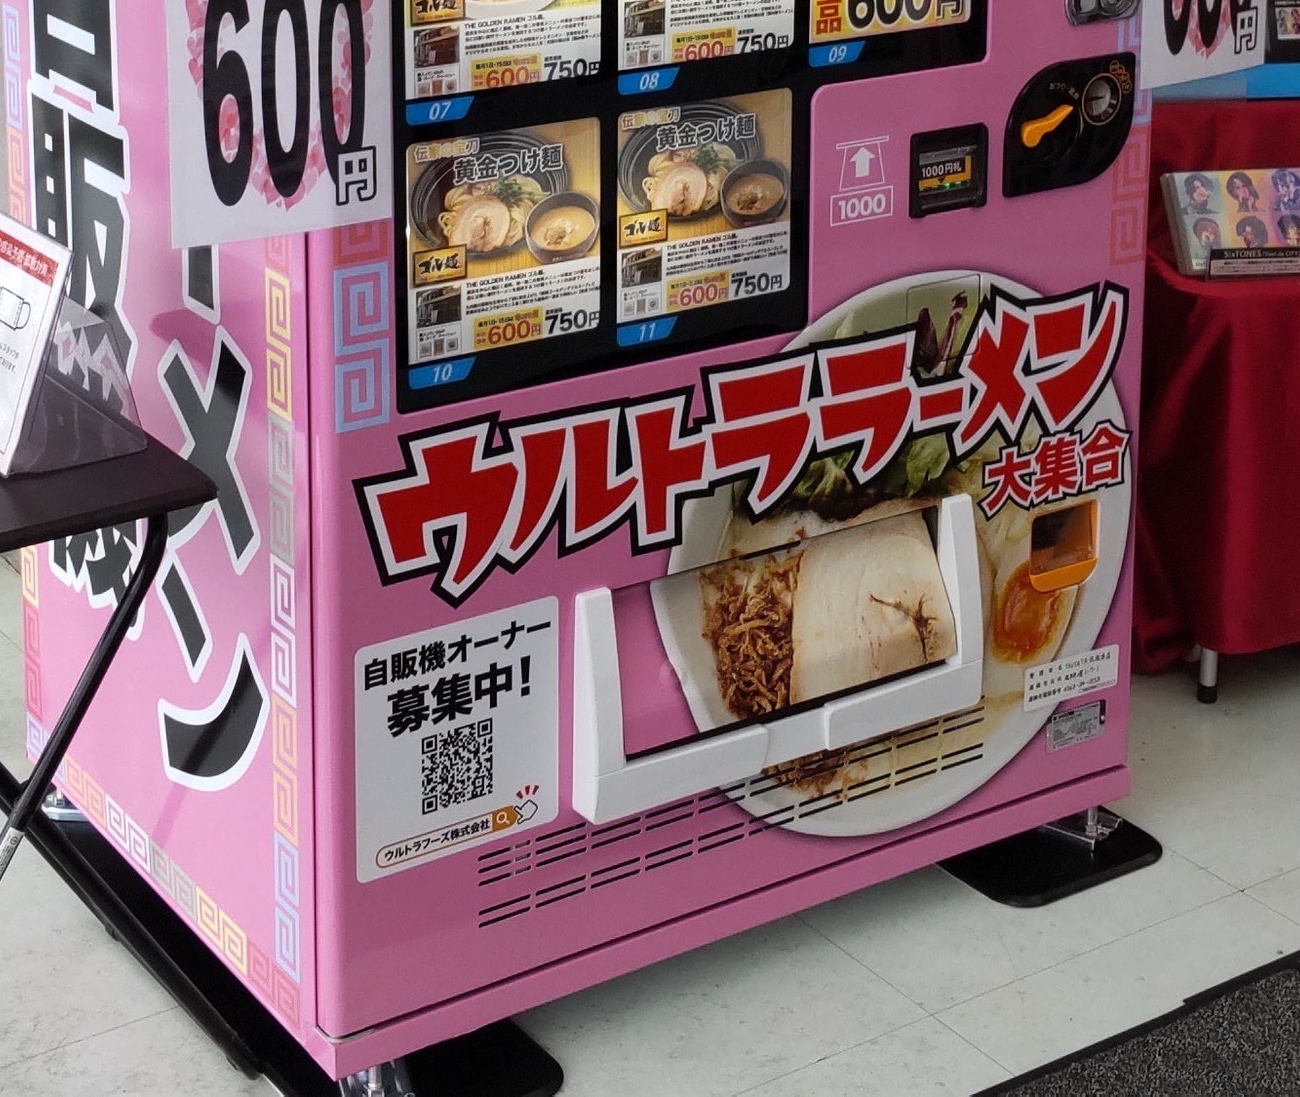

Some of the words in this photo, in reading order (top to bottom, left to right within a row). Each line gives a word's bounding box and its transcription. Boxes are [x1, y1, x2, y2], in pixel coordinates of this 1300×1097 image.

[738, 33, 789, 54] 750円
[828, 46, 847, 63] 09
[640, 72, 659, 90] 08
[429, 102, 451, 120] 07
[656, 113, 757, 152] 黄金つけ麺
[454, 144, 564, 185] 黄金つけ麺
[921, 161, 962, 178] 1000円札
[838, 193, 887, 220] 1000
[679, 283, 727, 307] 600円
[731, 274, 783, 297] 750円
[488, 319, 541, 345] 600円
[545, 309, 600, 333] 750円
[639, 323, 655, 340] 11
[433, 365, 452, 382] 10
[352, 288, 1131, 609] ウルトララーメン
[980, 422, 1132, 516] 大集合
[364, 620, 552, 691] 自販機オーナー
[387, 655, 532, 738] 募集中!
[384, 818, 491, 862] ウルトラフーズ株式会社
